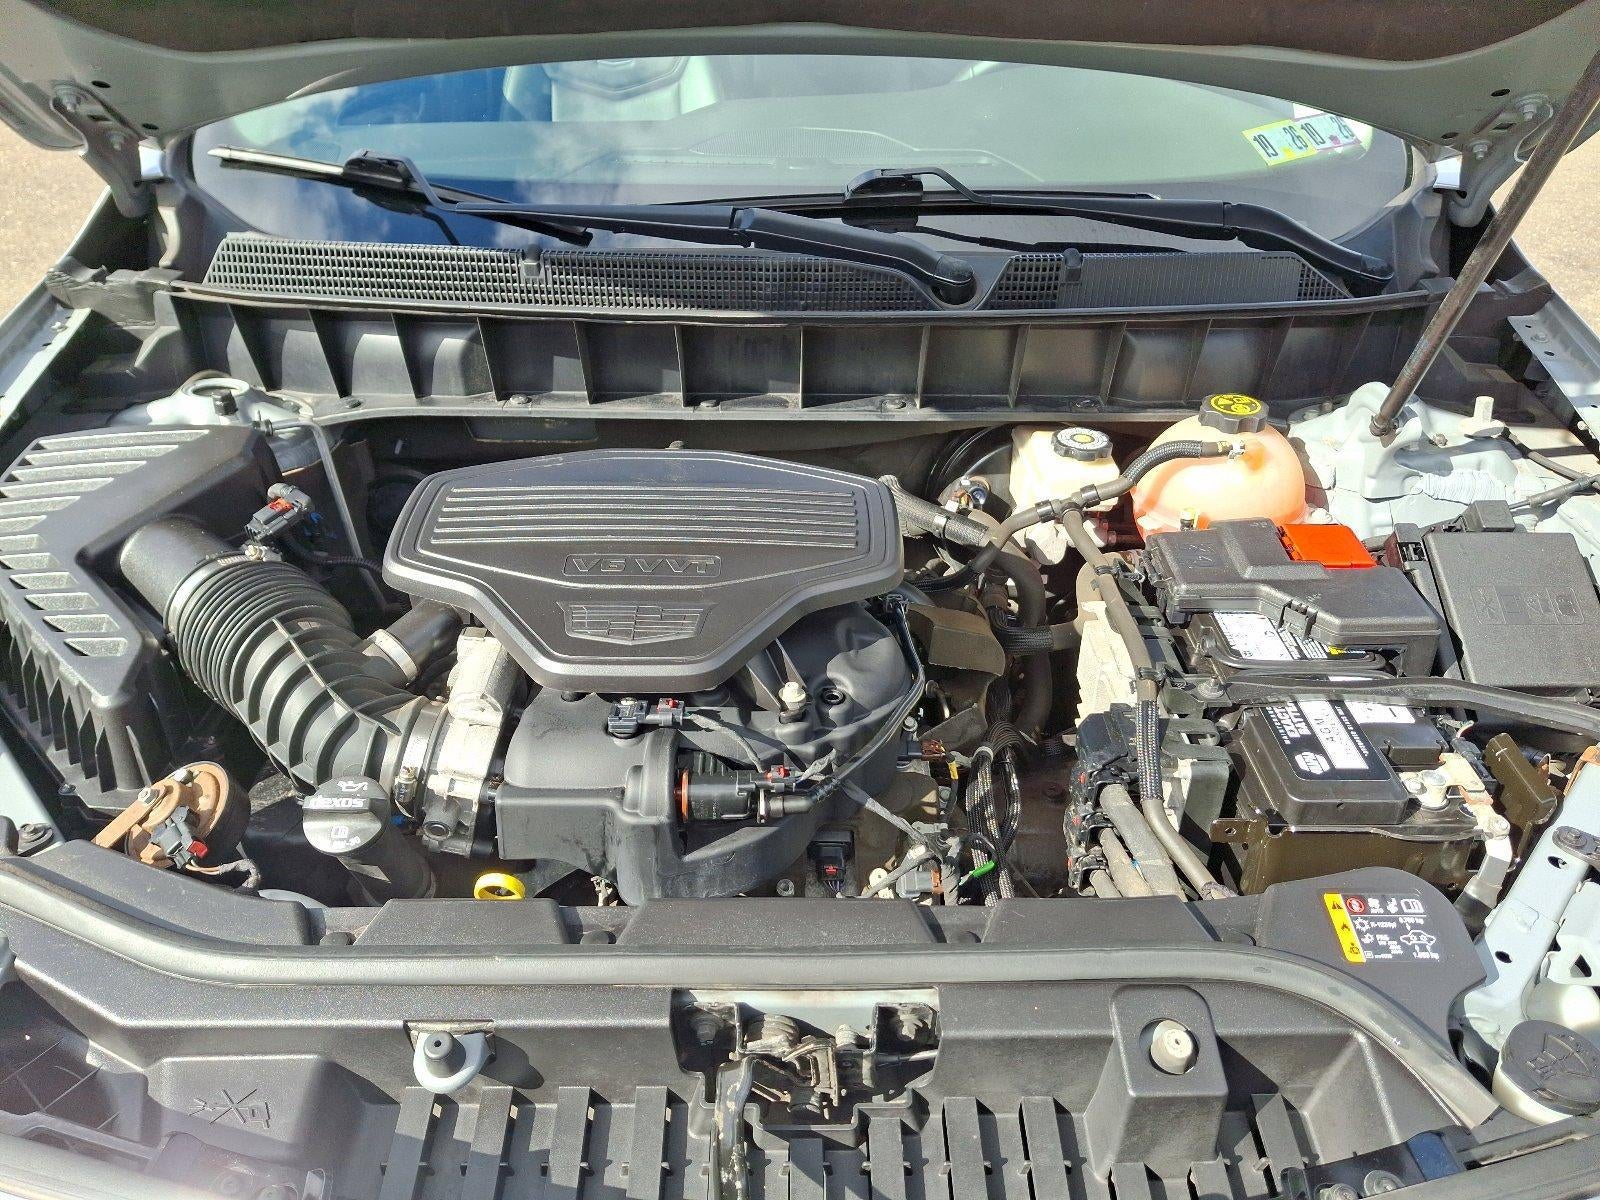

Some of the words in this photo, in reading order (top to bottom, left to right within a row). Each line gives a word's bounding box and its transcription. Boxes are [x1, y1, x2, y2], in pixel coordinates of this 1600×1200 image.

[1253, 133, 1279, 158] 10
[1300, 122, 1326, 146] 10
[572, 558, 627, 573] V6
[634, 558, 716, 574] VVT
